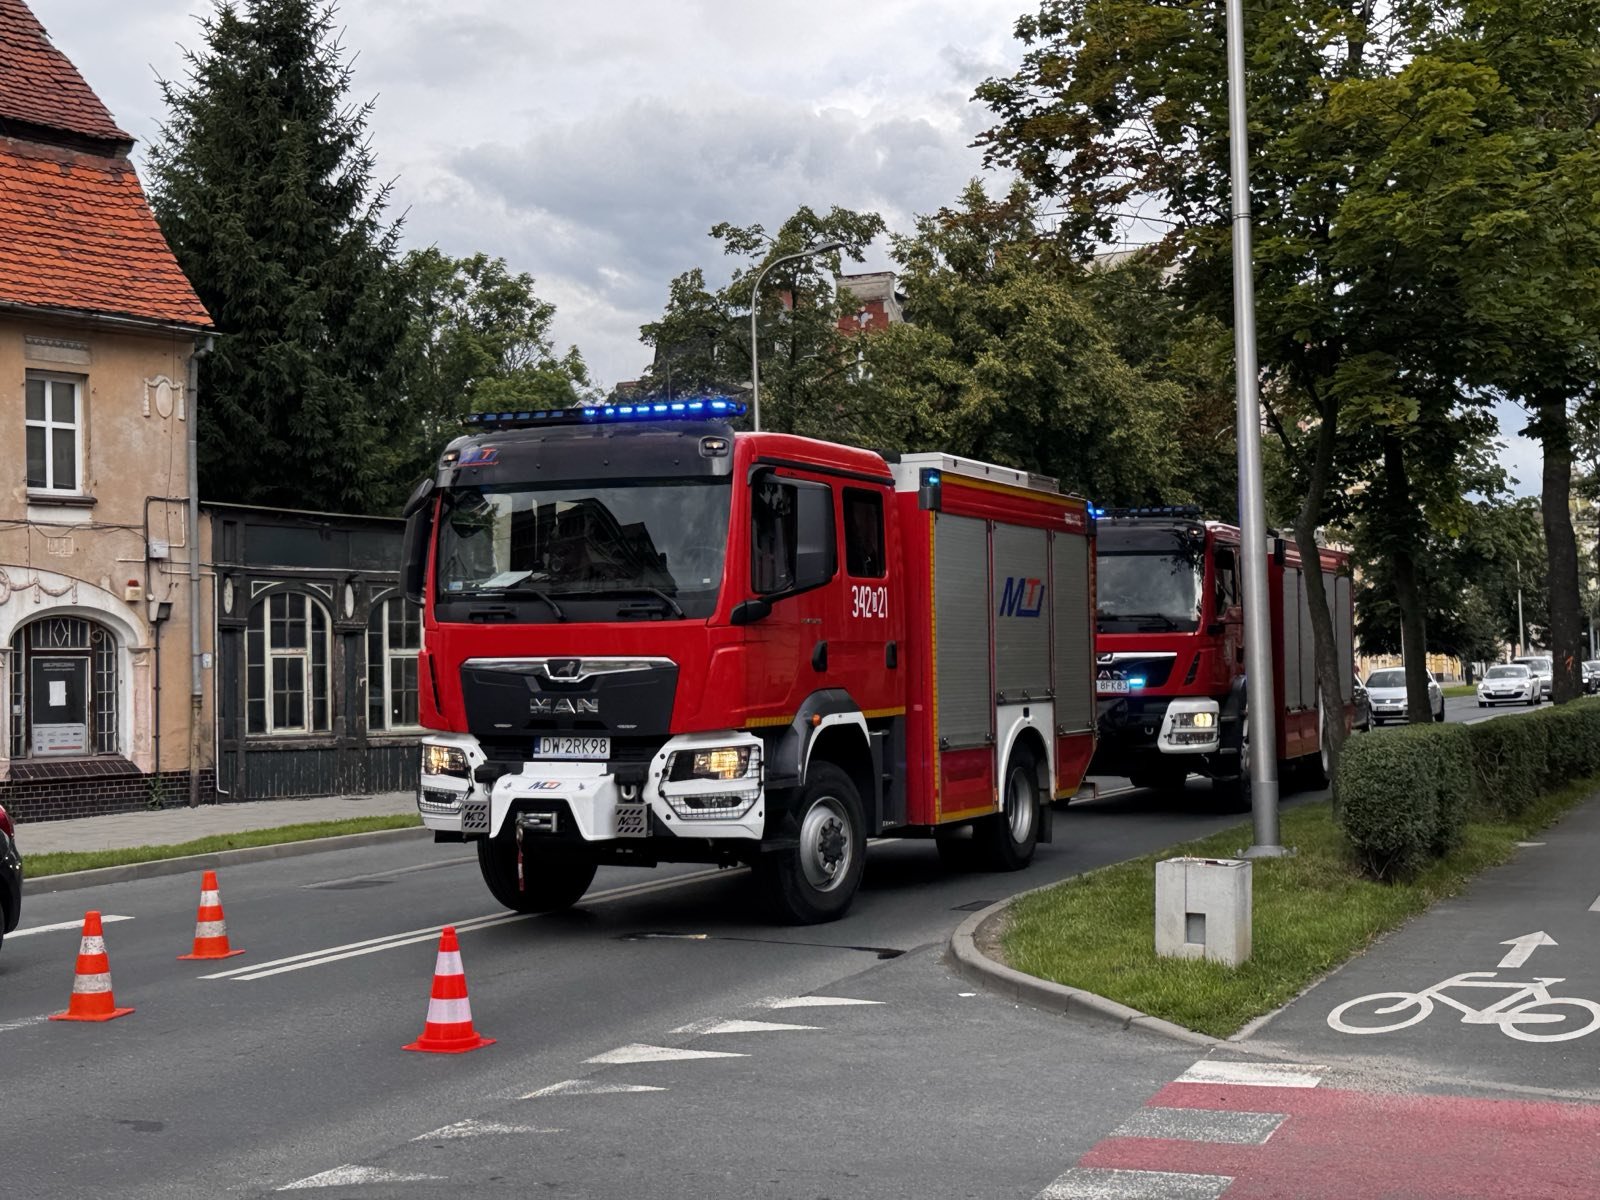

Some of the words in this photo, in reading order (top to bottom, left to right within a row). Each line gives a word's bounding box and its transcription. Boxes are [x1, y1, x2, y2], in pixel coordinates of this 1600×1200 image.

[529, 698, 599, 714] MAN
[543, 738, 561, 753] DW
[565, 738, 607, 754] 2RK98
